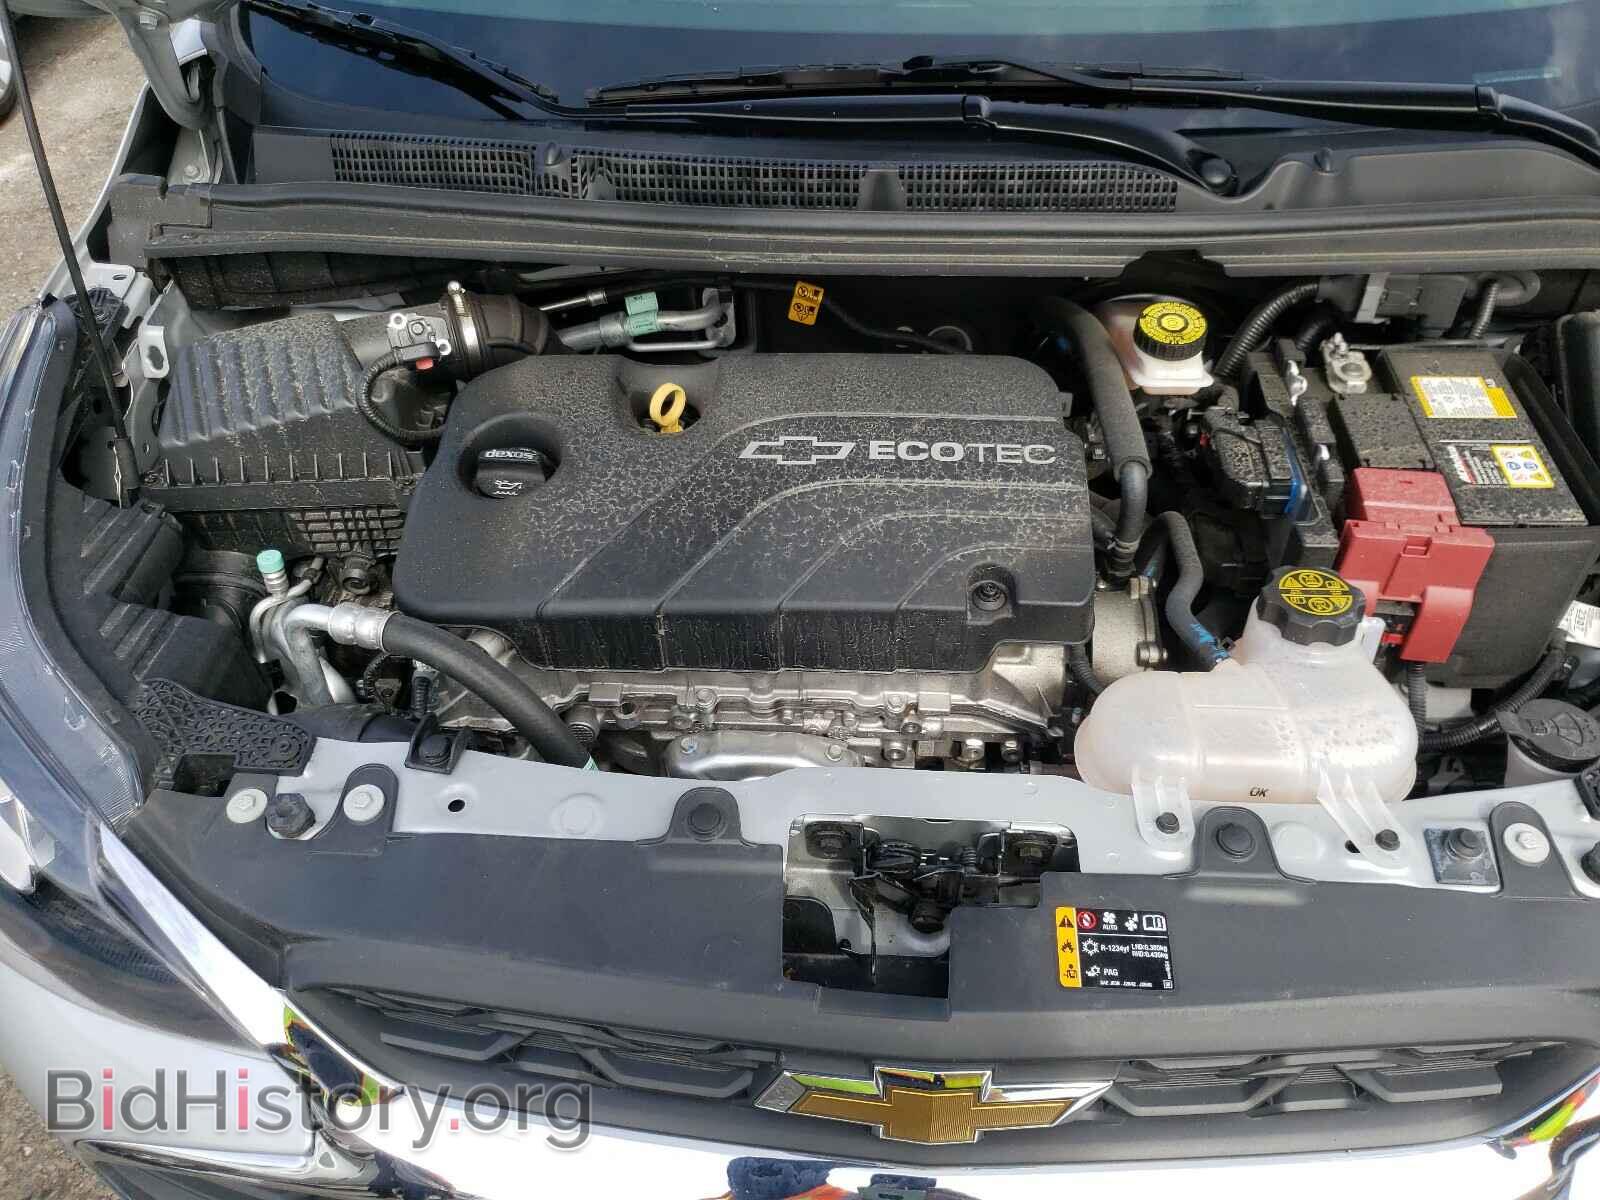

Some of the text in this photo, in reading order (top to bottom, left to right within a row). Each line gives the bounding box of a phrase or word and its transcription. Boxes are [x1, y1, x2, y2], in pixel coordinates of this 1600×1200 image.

[868, 440, 1057, 464] ECOTEC
[1249, 786, 1270, 798] OK
[1100, 944, 1130, 954] R-1234yf
[1103, 967, 1119, 977] PAG
